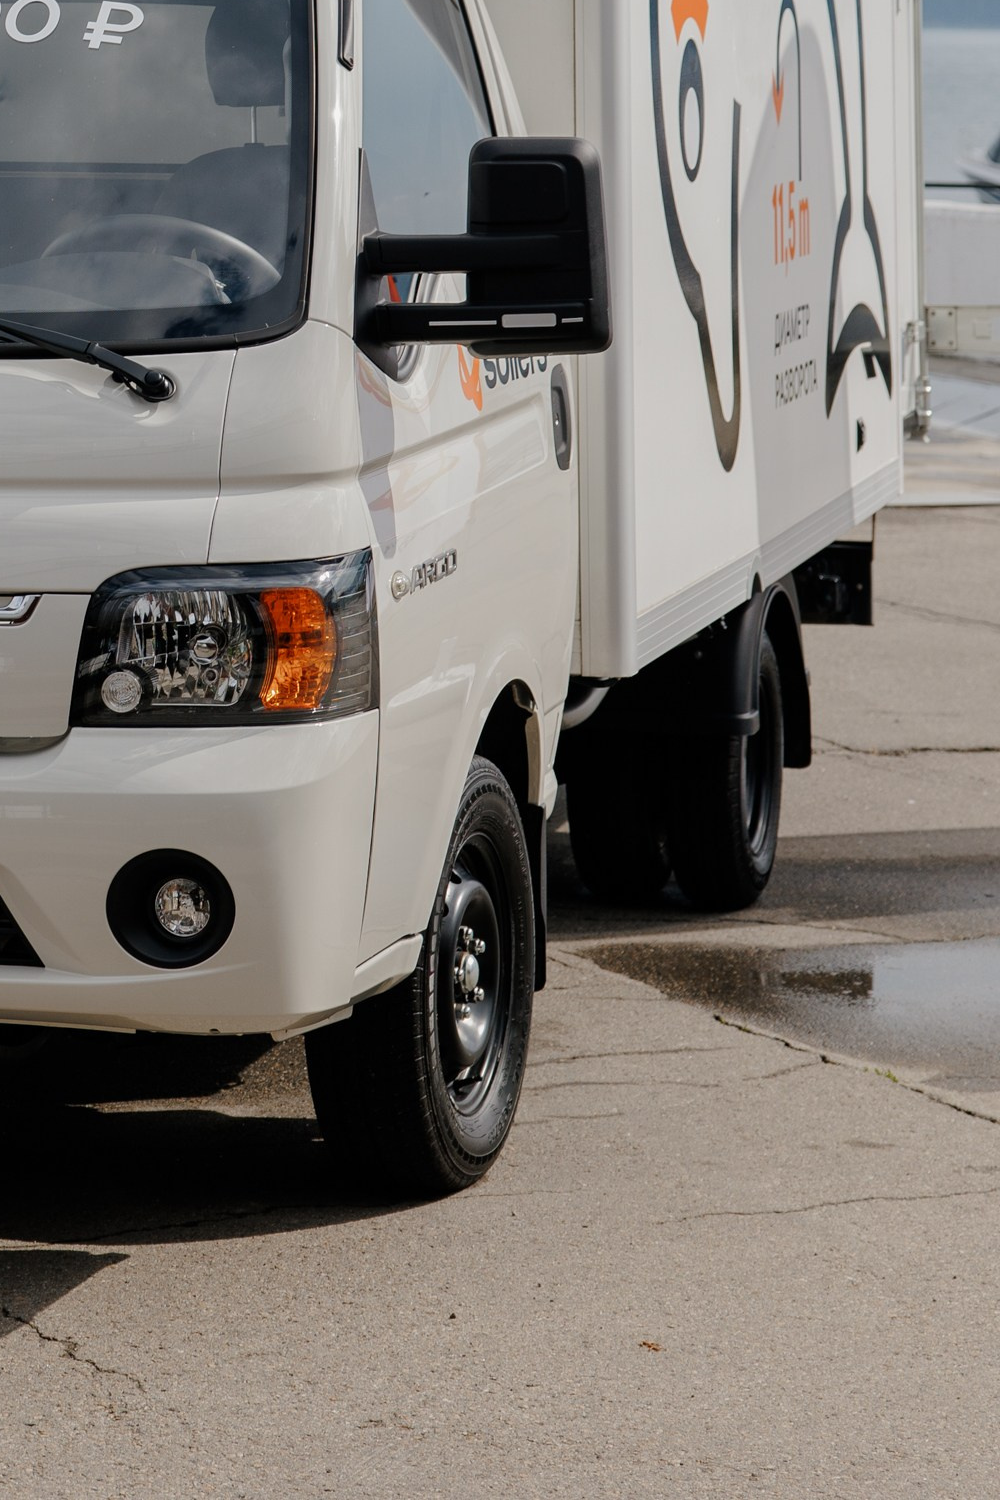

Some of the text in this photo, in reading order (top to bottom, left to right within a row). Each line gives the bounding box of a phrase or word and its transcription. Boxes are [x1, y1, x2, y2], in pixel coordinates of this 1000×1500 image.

[772, 180, 796, 277] 11,5
[774, 303, 812, 356] ДИАМЕТР
[775, 359, 819, 409] РАЗВОРОТА
[409, 548, 458, 596] ARGO
